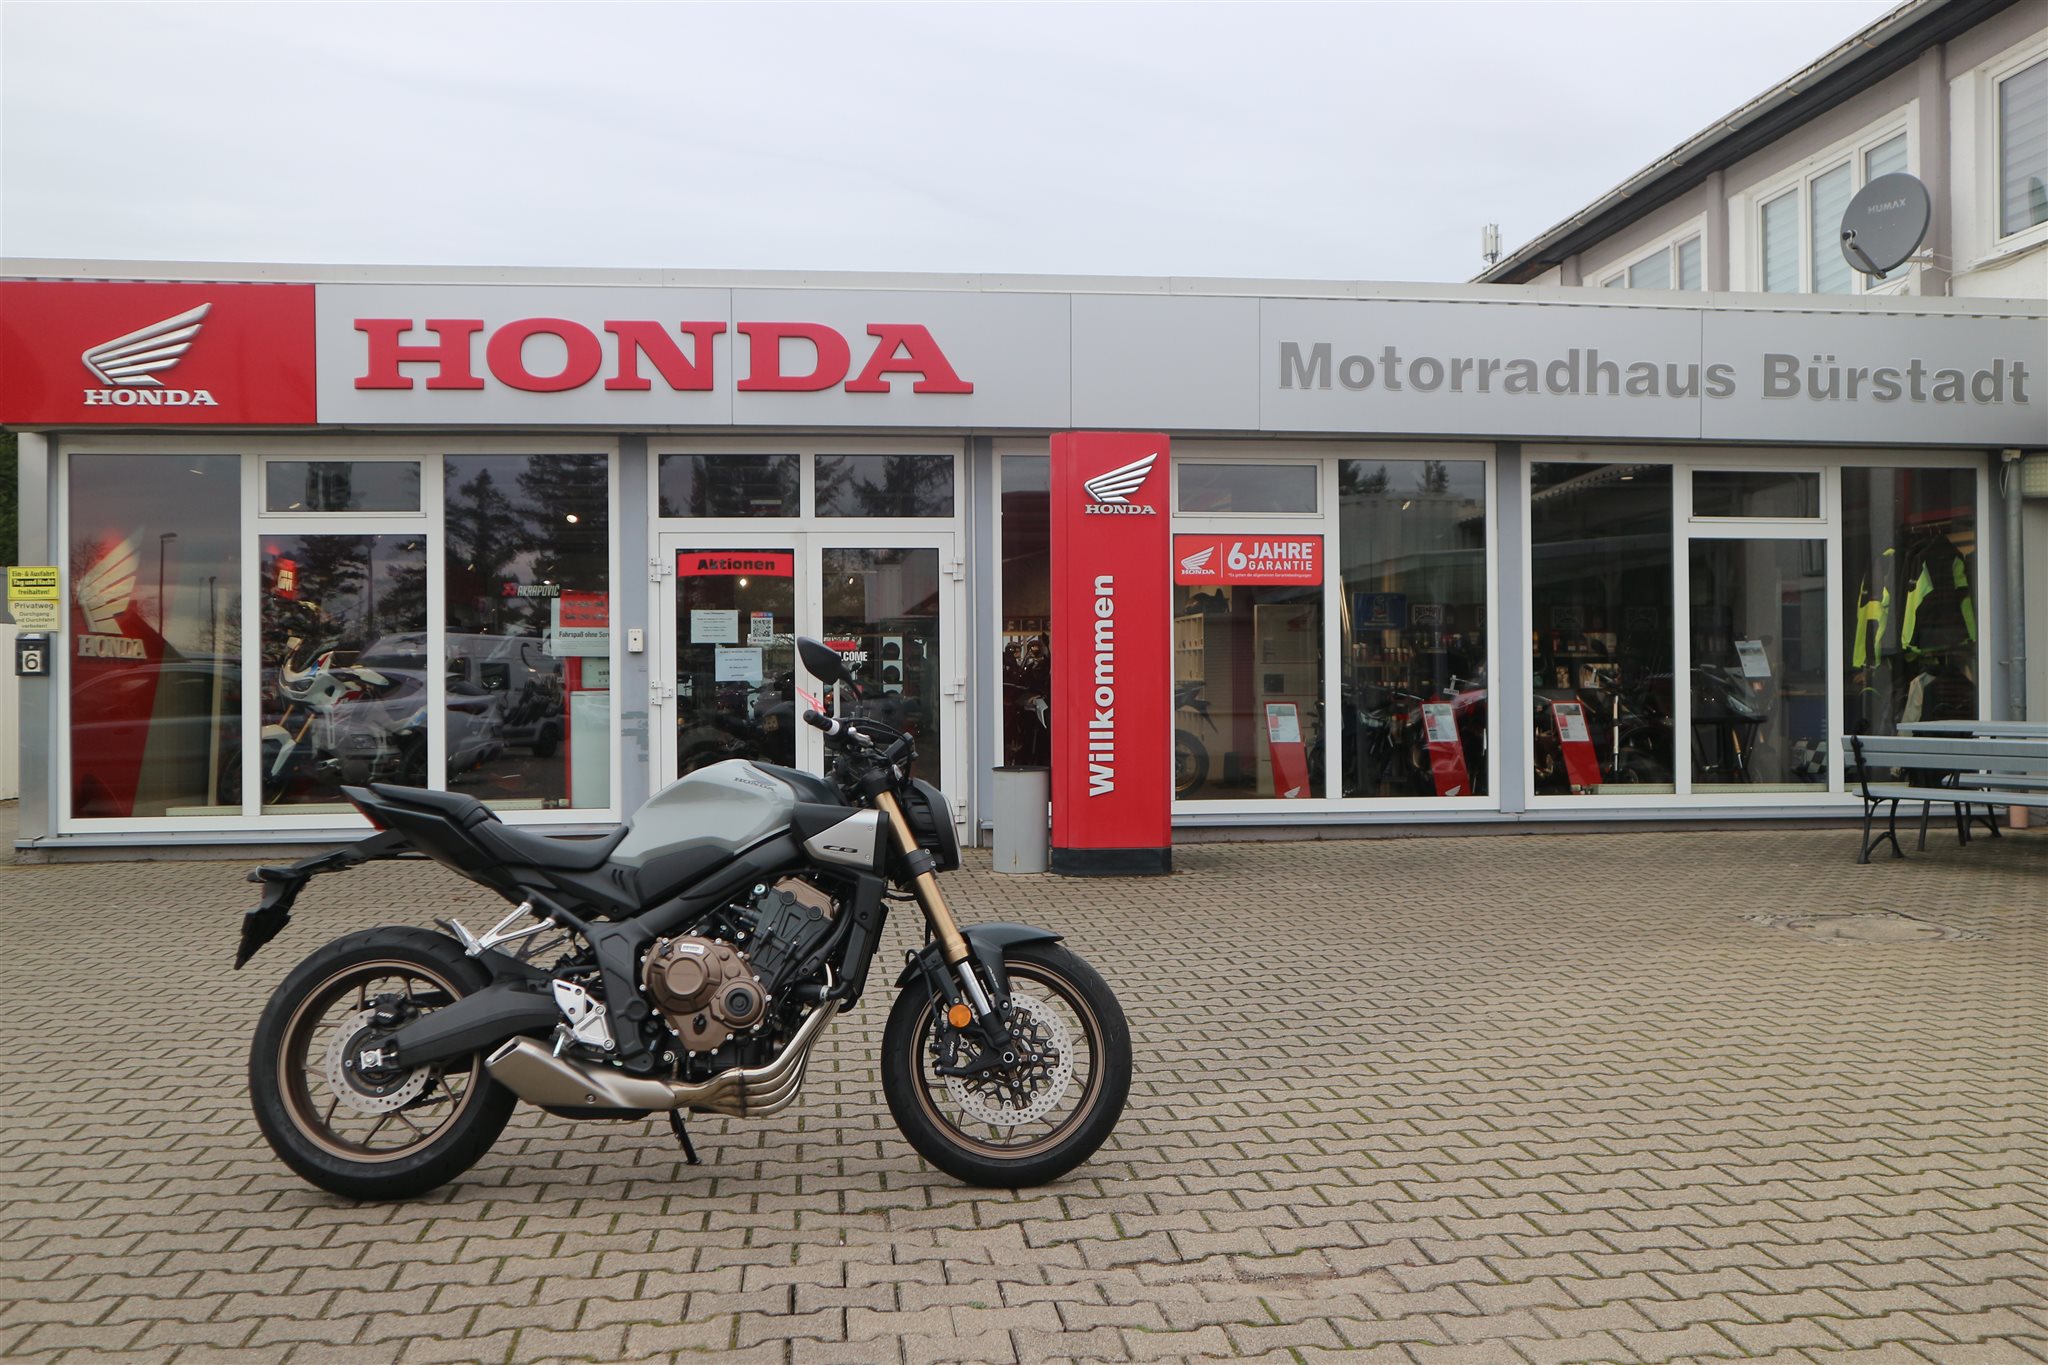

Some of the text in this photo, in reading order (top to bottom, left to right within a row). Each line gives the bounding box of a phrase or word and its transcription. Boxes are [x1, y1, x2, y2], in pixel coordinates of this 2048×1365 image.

[1868, 198, 1906, 214] HUMAX
[354, 317, 974, 394] HONDA
[1279, 341, 2031, 404] Motorradhaus Bürstadt
[84, 389, 219, 406] HONDA
[1085, 504, 1157, 515] HONDA
[697, 558, 776, 571] Aktionen
[1227, 542, 1248, 570] 6
[1248, 560, 1313, 571] GARANTIE
[559, 631, 583, 639] Fahrspaß
[77, 634, 148, 659] HONDA
[25, 653, 39, 670] 6
[1089, 575, 1115, 797] Willkommen
[734, 777, 775, 792] HONDA
